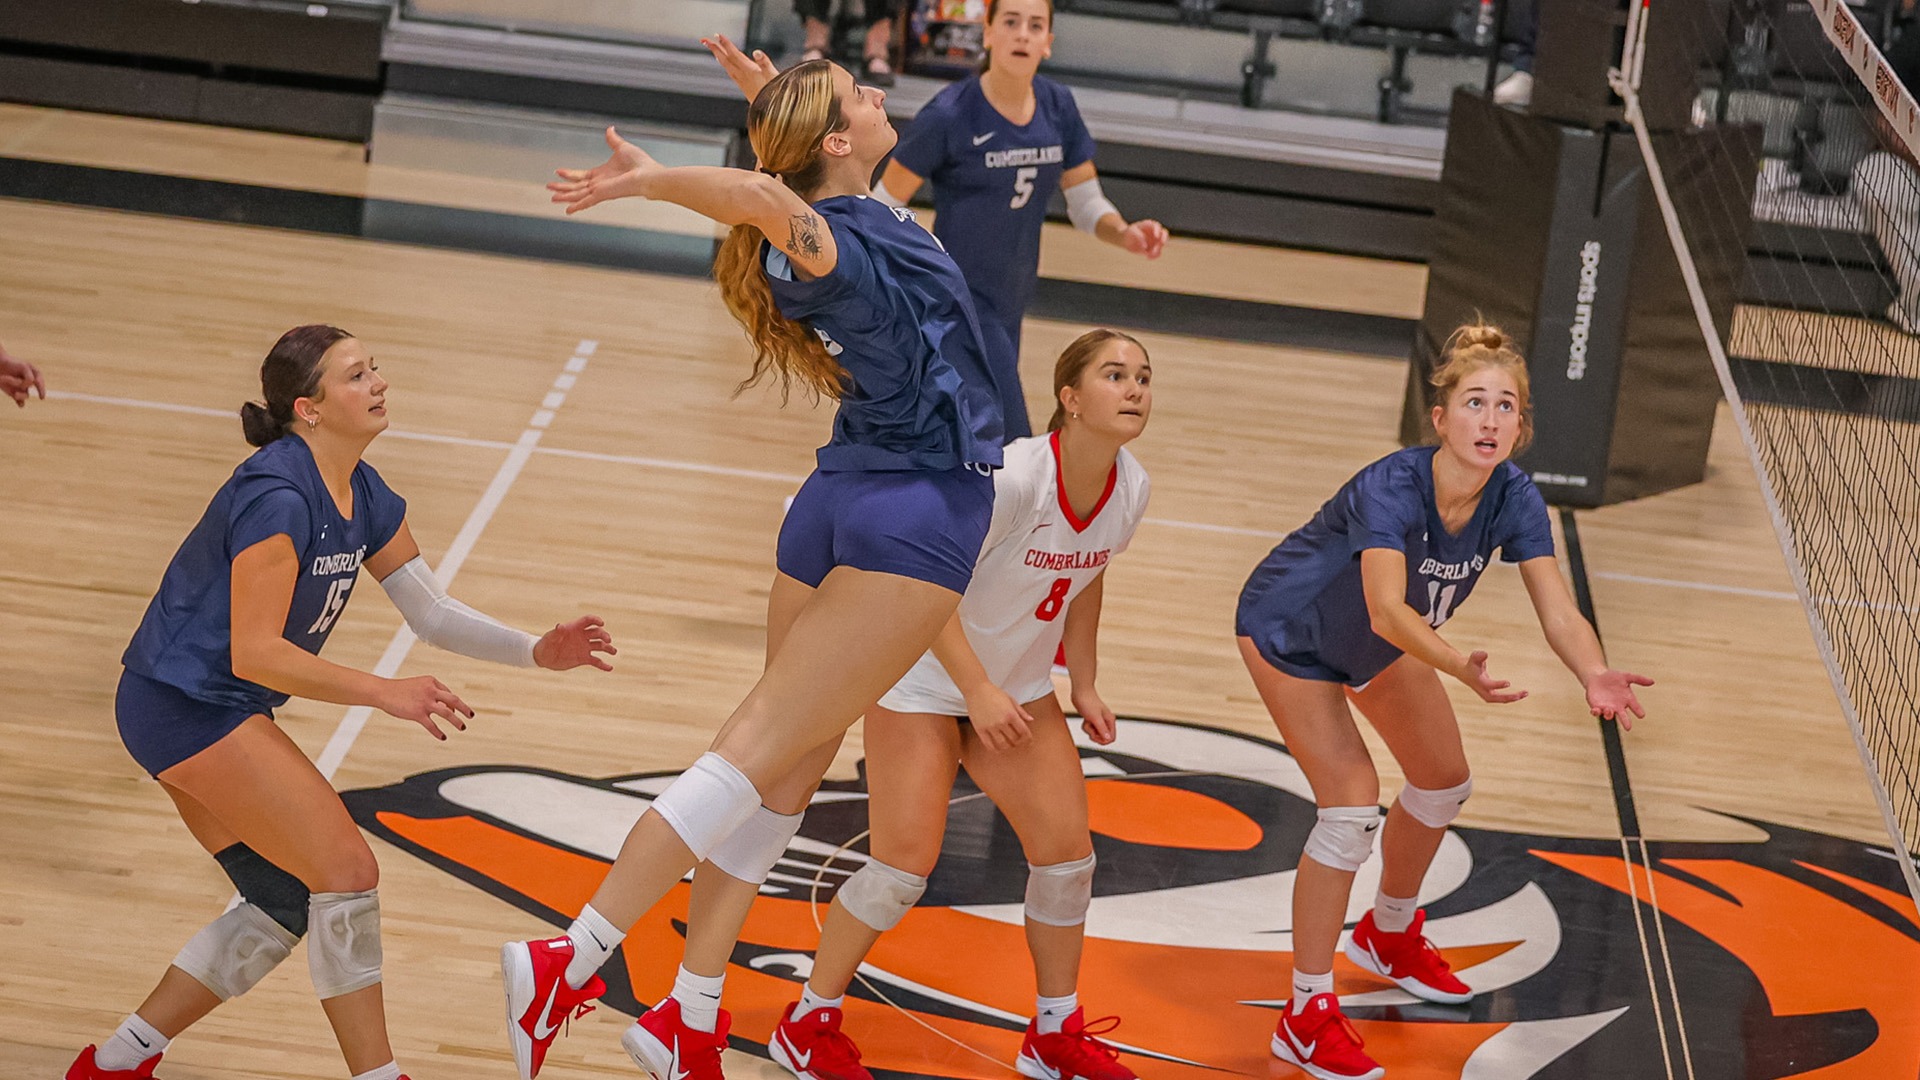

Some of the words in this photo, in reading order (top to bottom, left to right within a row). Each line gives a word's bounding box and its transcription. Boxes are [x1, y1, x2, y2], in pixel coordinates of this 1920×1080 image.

[1009, 167, 1038, 210] 5
[1577, 240, 1602, 303] sports
[1566, 304, 1592, 380] imports
[306, 577, 354, 635] 15
[1034, 577, 1073, 622] 8
[1420, 580, 1458, 627] 11
